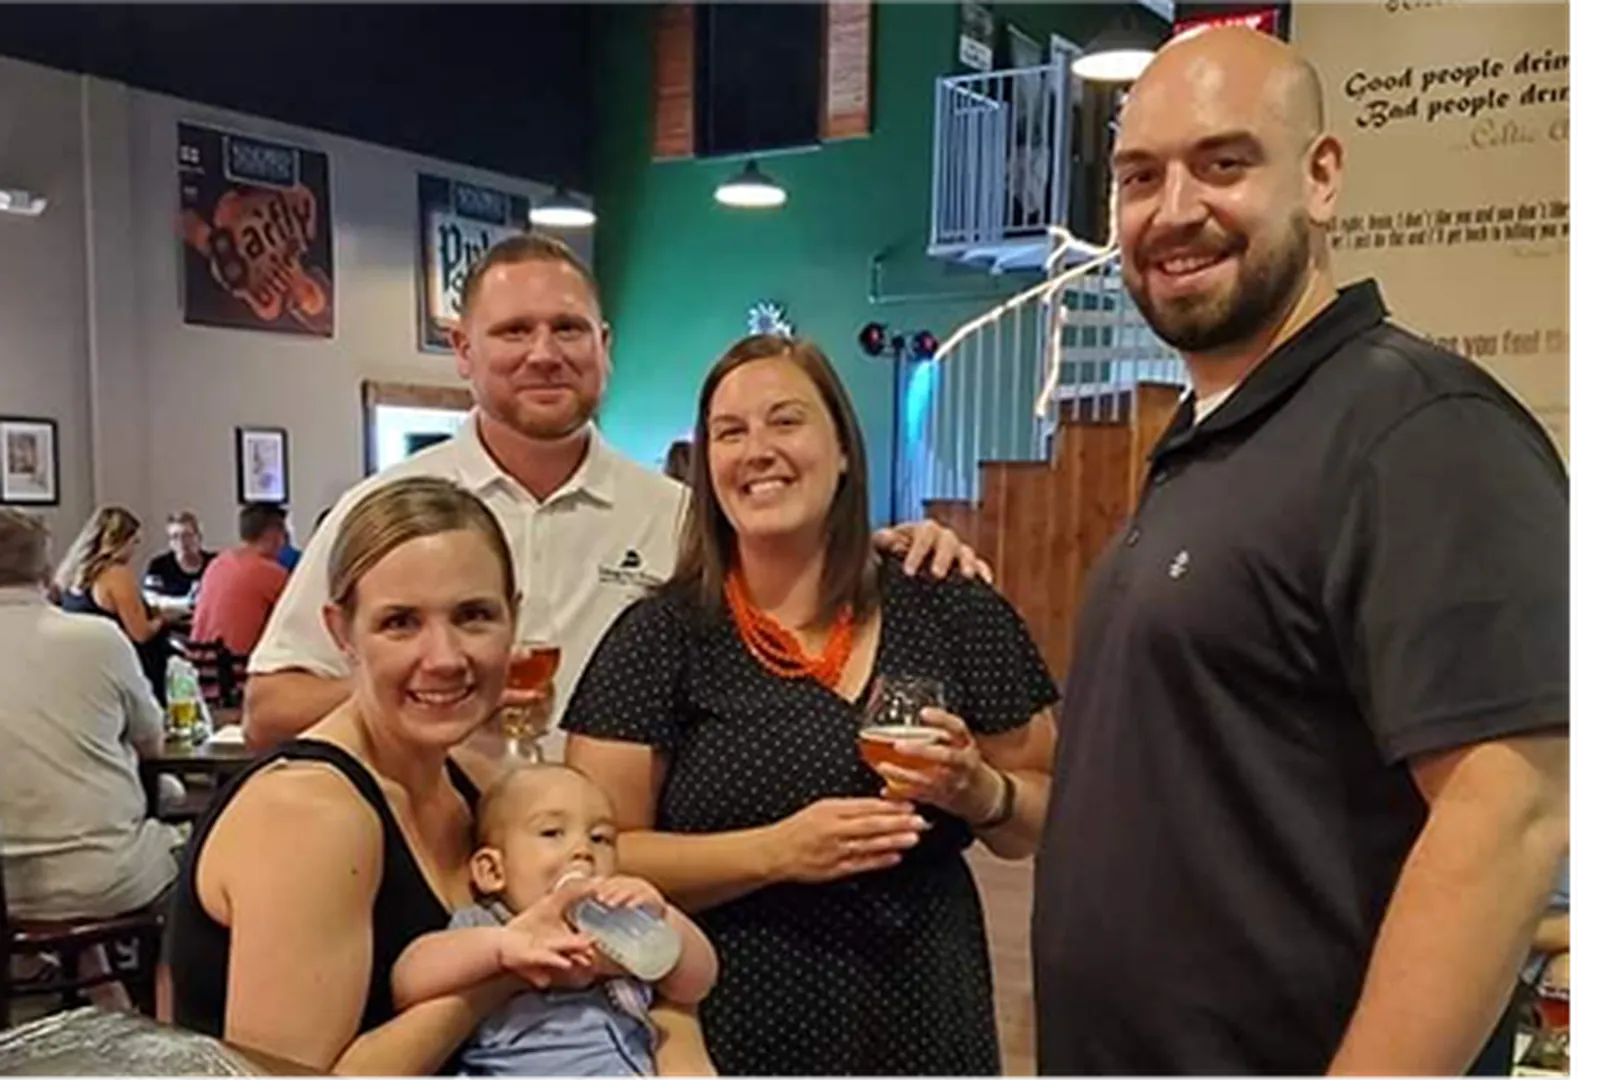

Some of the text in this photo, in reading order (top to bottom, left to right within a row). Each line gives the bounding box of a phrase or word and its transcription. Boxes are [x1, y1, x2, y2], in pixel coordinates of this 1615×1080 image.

[1346, 68, 1412, 99] Good
[1422, 58, 1503, 93] people
[1356, 97, 1418, 128] Bad
[1427, 88, 1509, 122] people
